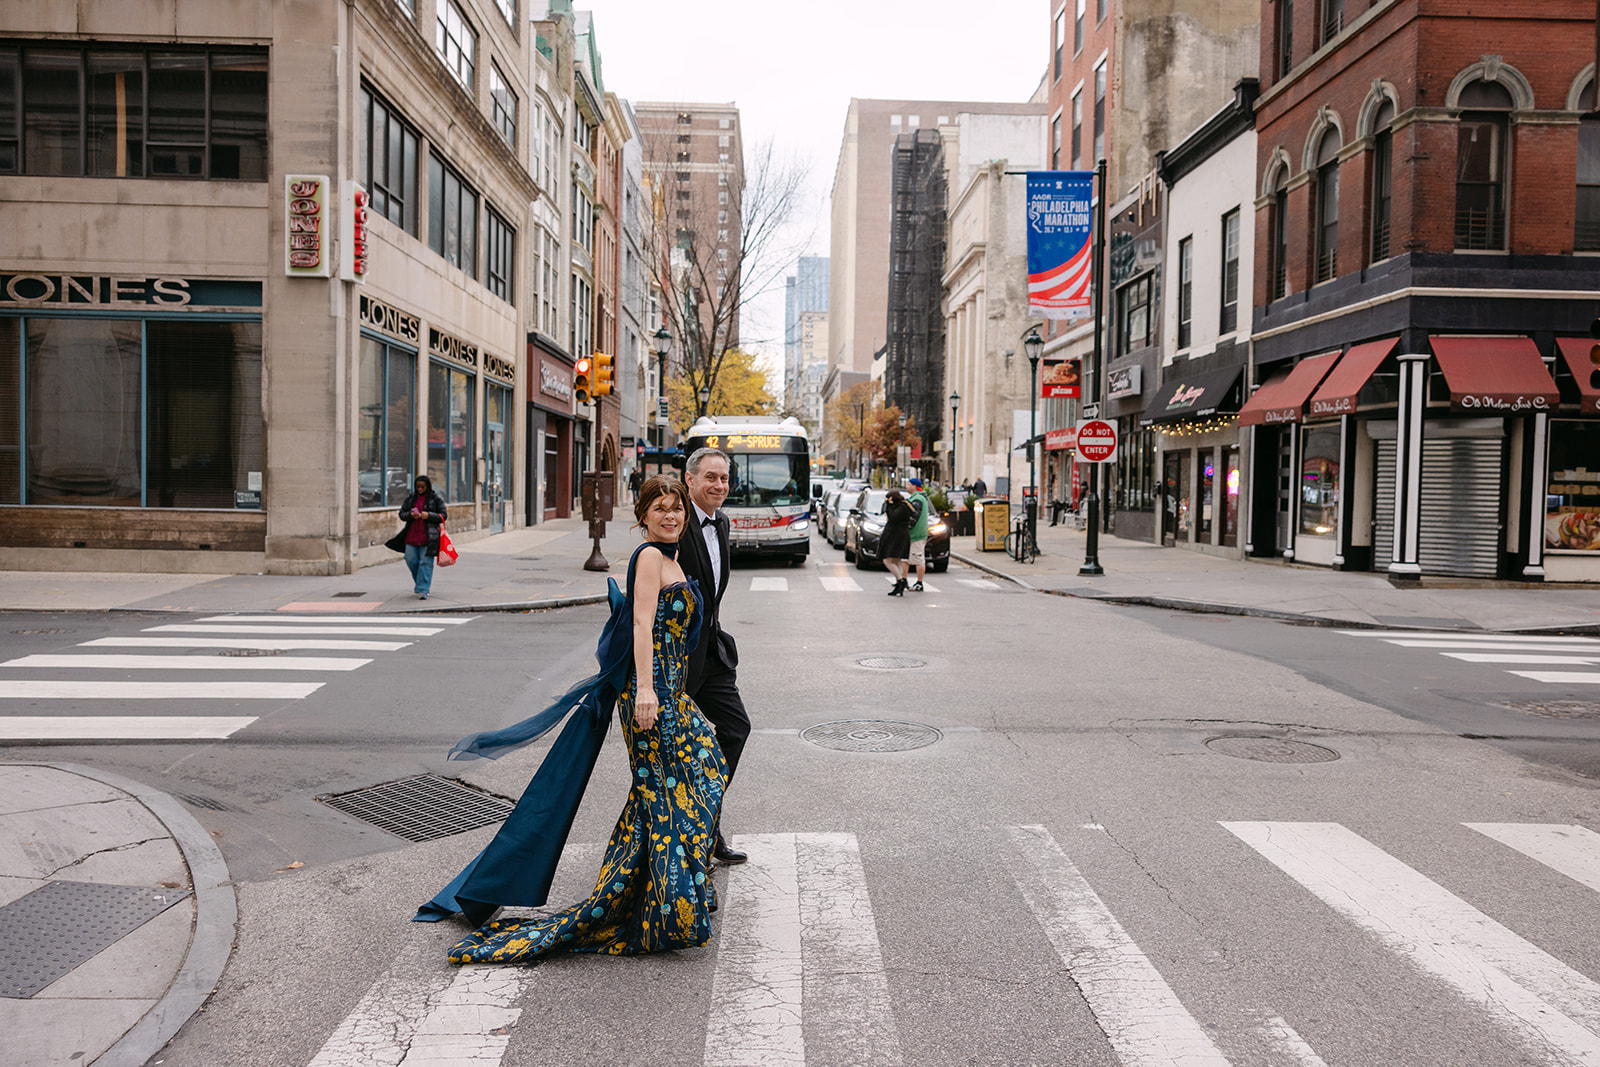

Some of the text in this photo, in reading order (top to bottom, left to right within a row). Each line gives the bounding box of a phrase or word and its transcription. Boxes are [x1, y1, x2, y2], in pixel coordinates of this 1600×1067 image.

[1031, 200, 1089, 213] PHILADELPHIA
[288, 181, 320, 268] JONES
[1044, 213, 1089, 226] MARATHON
[0, 274, 192, 306] ONES
[361, 299, 419, 342] JONES
[434, 331, 475, 366] JONES
[484, 354, 515, 381] JONES
[1461, 395, 1481, 408] Old
[1082, 428, 1111, 436] DO NOT
[706, 435, 719, 448] 42
[1085, 446, 1108, 454] ENTER
[736, 518, 771, 529] SEPTA
